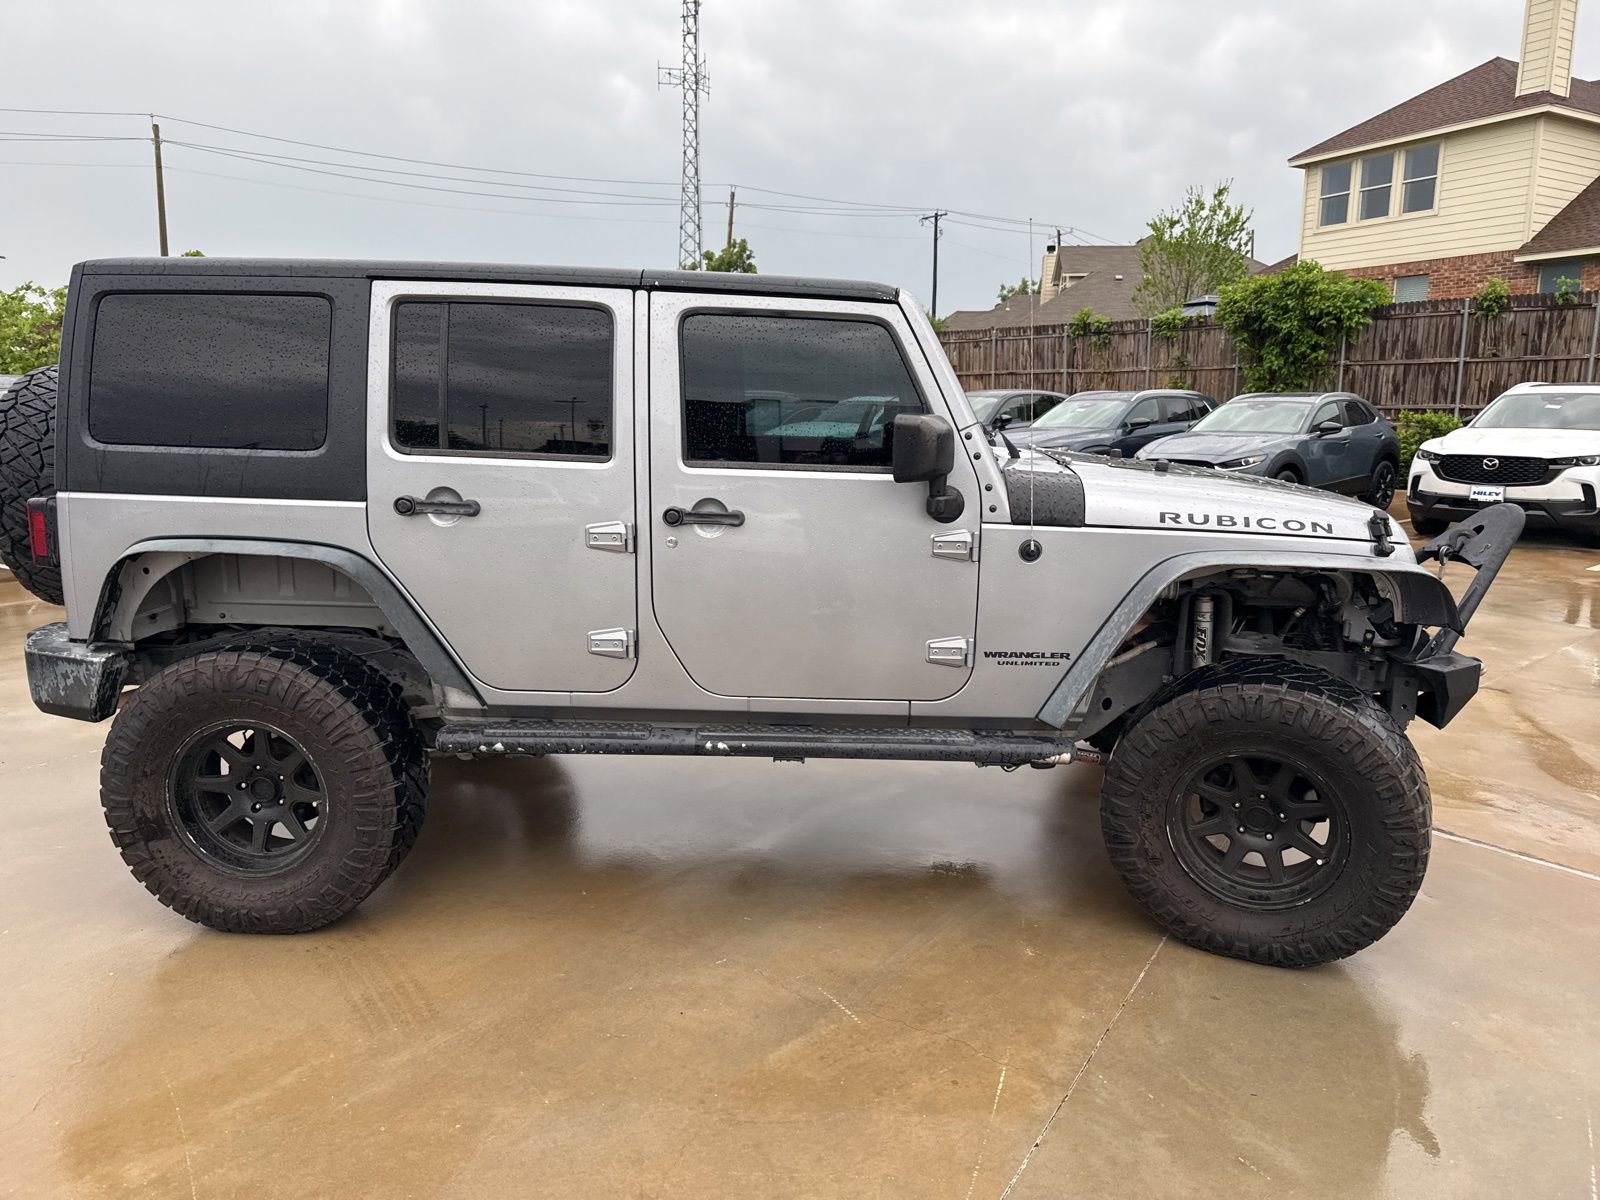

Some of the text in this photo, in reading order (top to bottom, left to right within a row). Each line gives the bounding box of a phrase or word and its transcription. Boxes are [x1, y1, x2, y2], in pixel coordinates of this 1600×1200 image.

[1159, 511, 1334, 534] RUBICON
[1195, 625, 1207, 662] FOX
[983, 651, 1071, 660] WRANGLER
